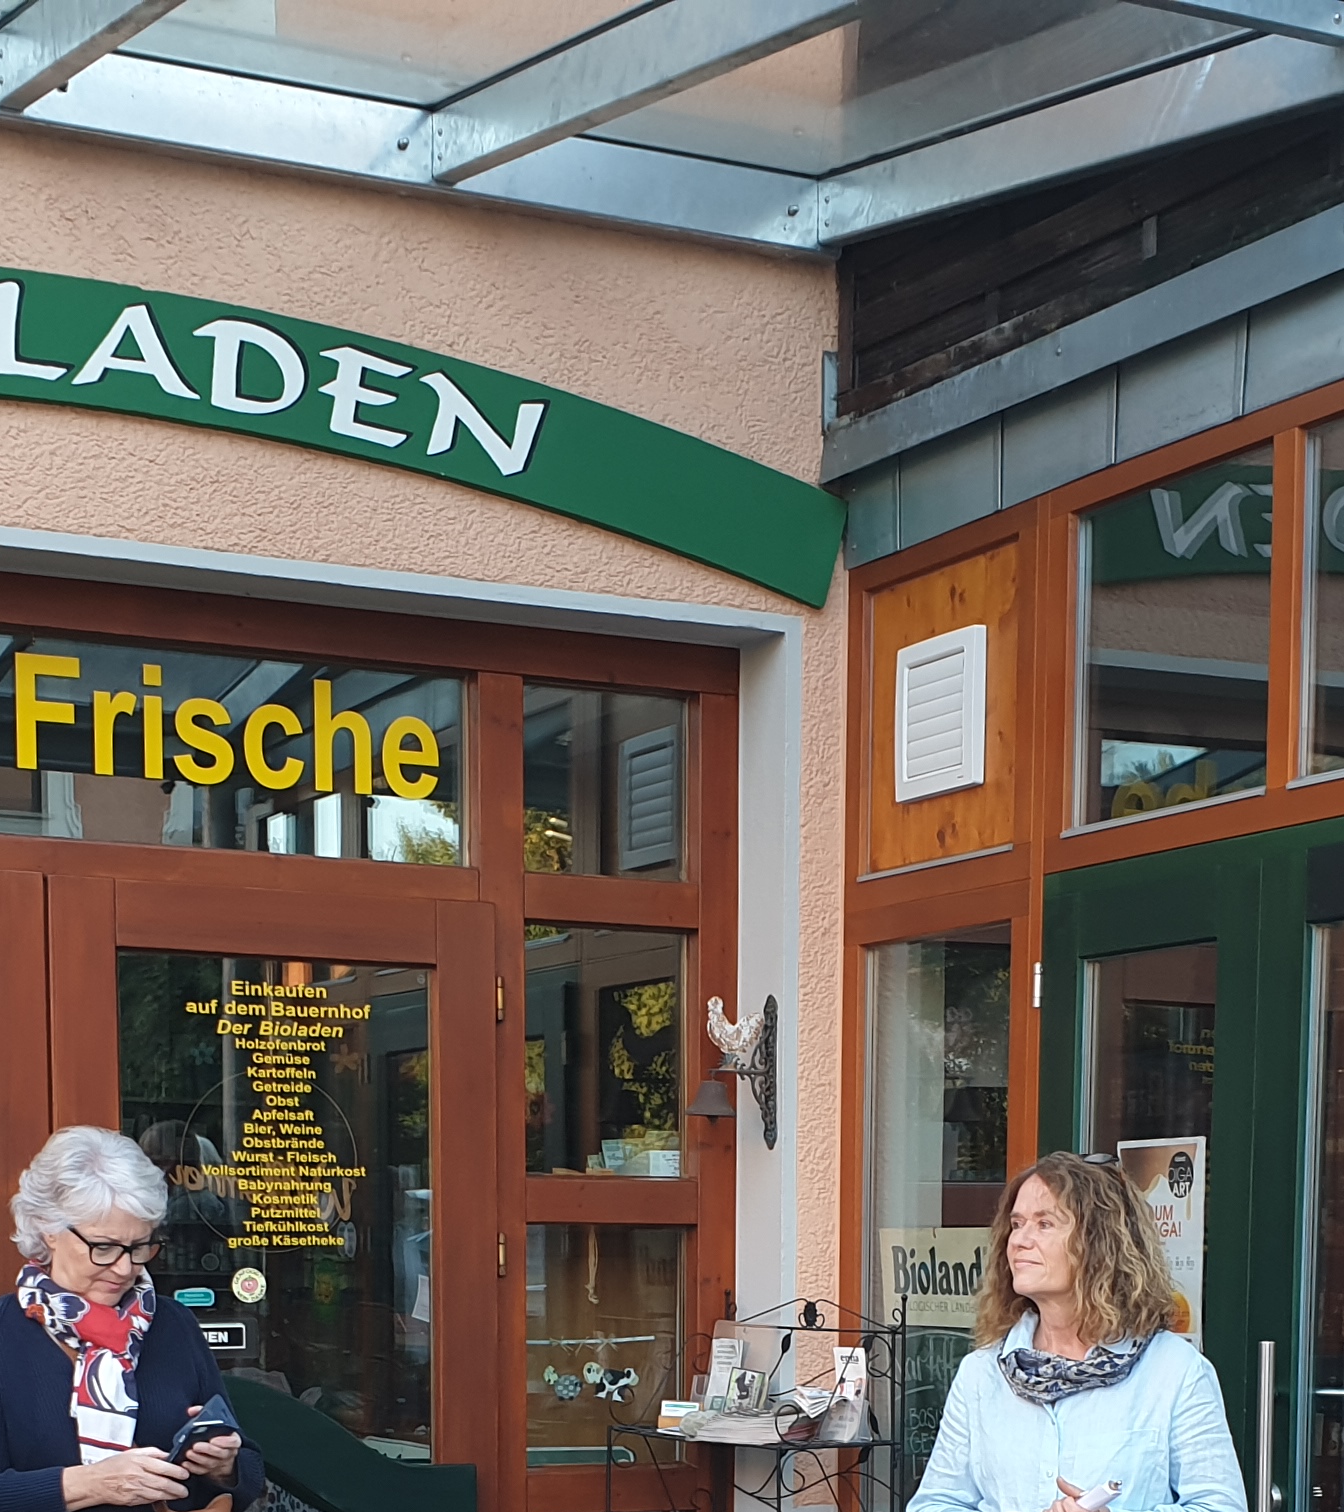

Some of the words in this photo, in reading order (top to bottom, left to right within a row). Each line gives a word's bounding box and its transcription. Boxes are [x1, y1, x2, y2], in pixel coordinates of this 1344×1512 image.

[13, 651, 442, 800] Frische
[231, 980, 328, 999] Einkaufen
[185, 1000, 218, 1015] auf
[224, 1001, 266, 1017] dem
[270, 1001, 371, 1020] Bauernhof
[216, 1020, 253, 1035] Der
[258, 1020, 344, 1038] Bioladen
[235, 1038, 326, 1052] Holzofenbrot
[252, 1052, 311, 1066] Gemüse
[247, 1067, 317, 1080] Kartoffeln
[252, 1081, 312, 1093] Getreide
[265, 1095, 300, 1107] Obst
[252, 1109, 315, 1122] Apfelsaft
[243, 1123, 276, 1136] Bier,
[279, 1123, 323, 1135] Weine
[242, 1136, 325, 1149] Obstbrände
[232, 1151, 274, 1163] Wurst
[286, 1152, 337, 1164] Fleisch
[202, 1164, 295, 1178] Vollsortiment
[299, 1166, 366, 1178] Naturkost
[237, 1179, 333, 1193] Babynahrung
[1173, 1182, 1191, 1197] ART
[252, 1193, 319, 1205] Kosmetik
[250, 1206, 322, 1219] Putzmittel
[242, 1220, 330, 1233] Tiefkühlkost
[1157, 1221, 1182, 1238] GA!
[227, 1235, 269, 1249] große
[272, 1235, 346, 1247] Käsetheke
[891, 1246, 984, 1297] Bioland
